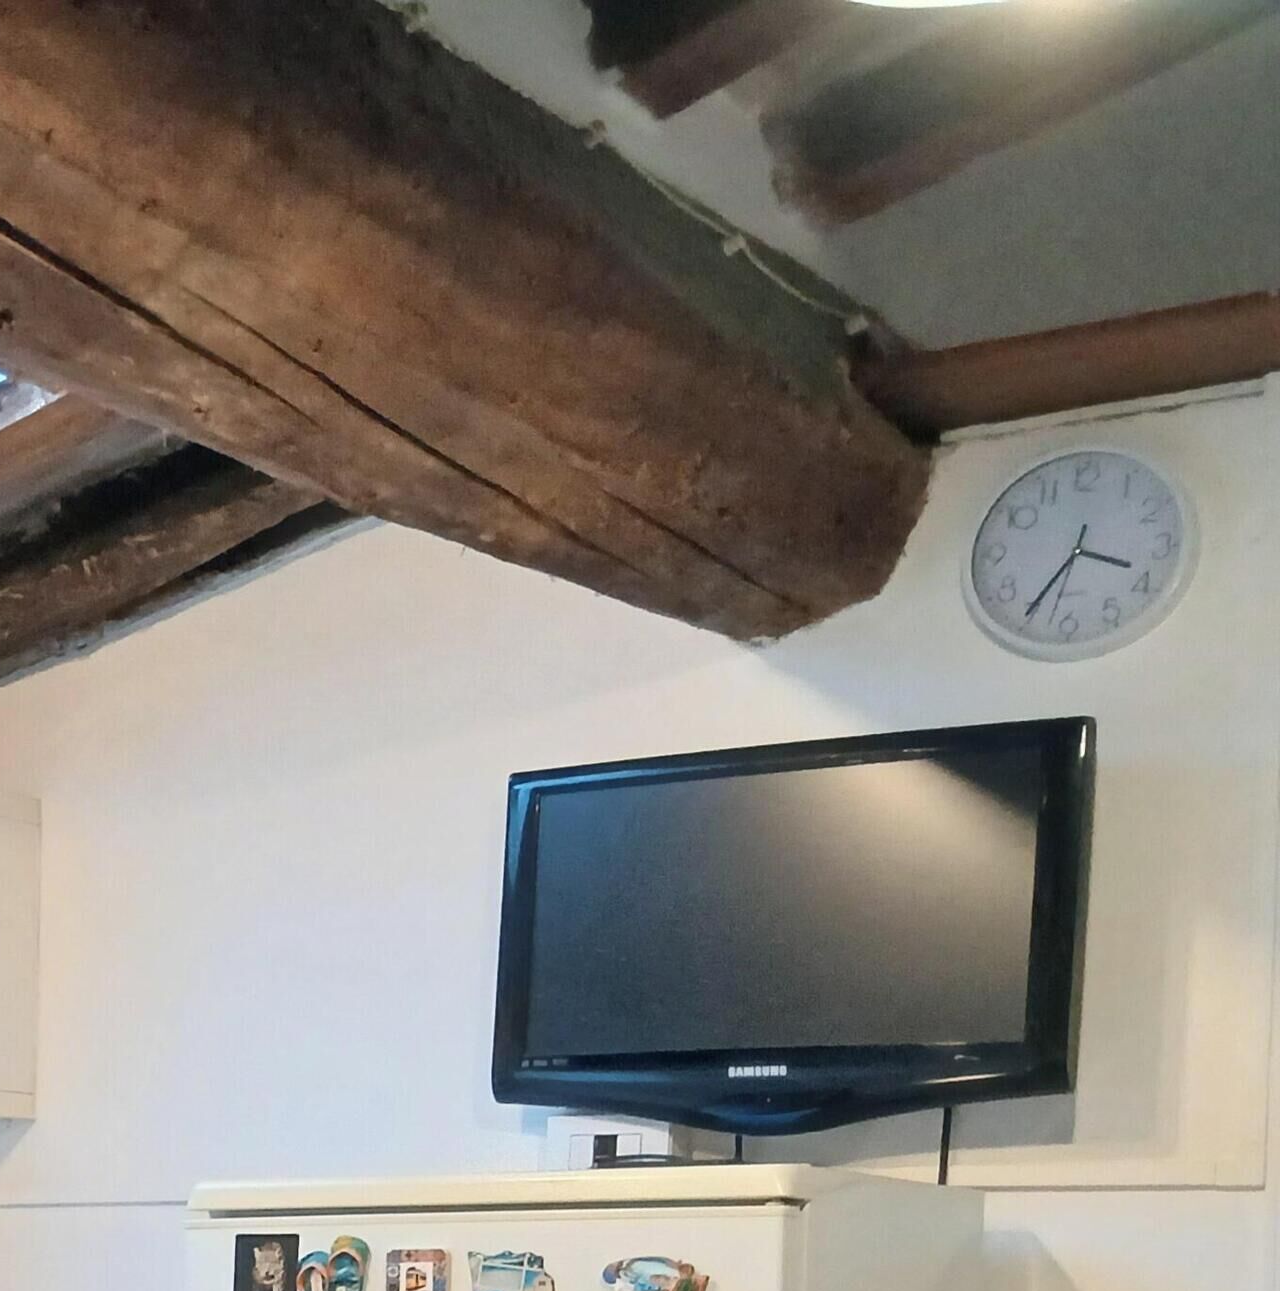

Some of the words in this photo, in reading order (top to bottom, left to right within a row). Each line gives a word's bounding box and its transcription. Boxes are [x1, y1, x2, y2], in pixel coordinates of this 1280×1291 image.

[1073, 461, 1101, 492] 12
[1123, 472, 1132, 499] 1
[1040, 479, 1059, 506] 11
[1007, 504, 1039, 531] 10
[1140, 498, 1159, 525] 2
[987, 542, 1007, 568] 9
[1151, 532, 1173, 560] 3
[996, 575, 1017, 602] 8
[1130, 570, 1151, 594] 4
[1101, 596, 1122, 624] 5
[1058, 611, 1080, 638] 6
[728, 1065, 788, 1079] SAMSUNG
